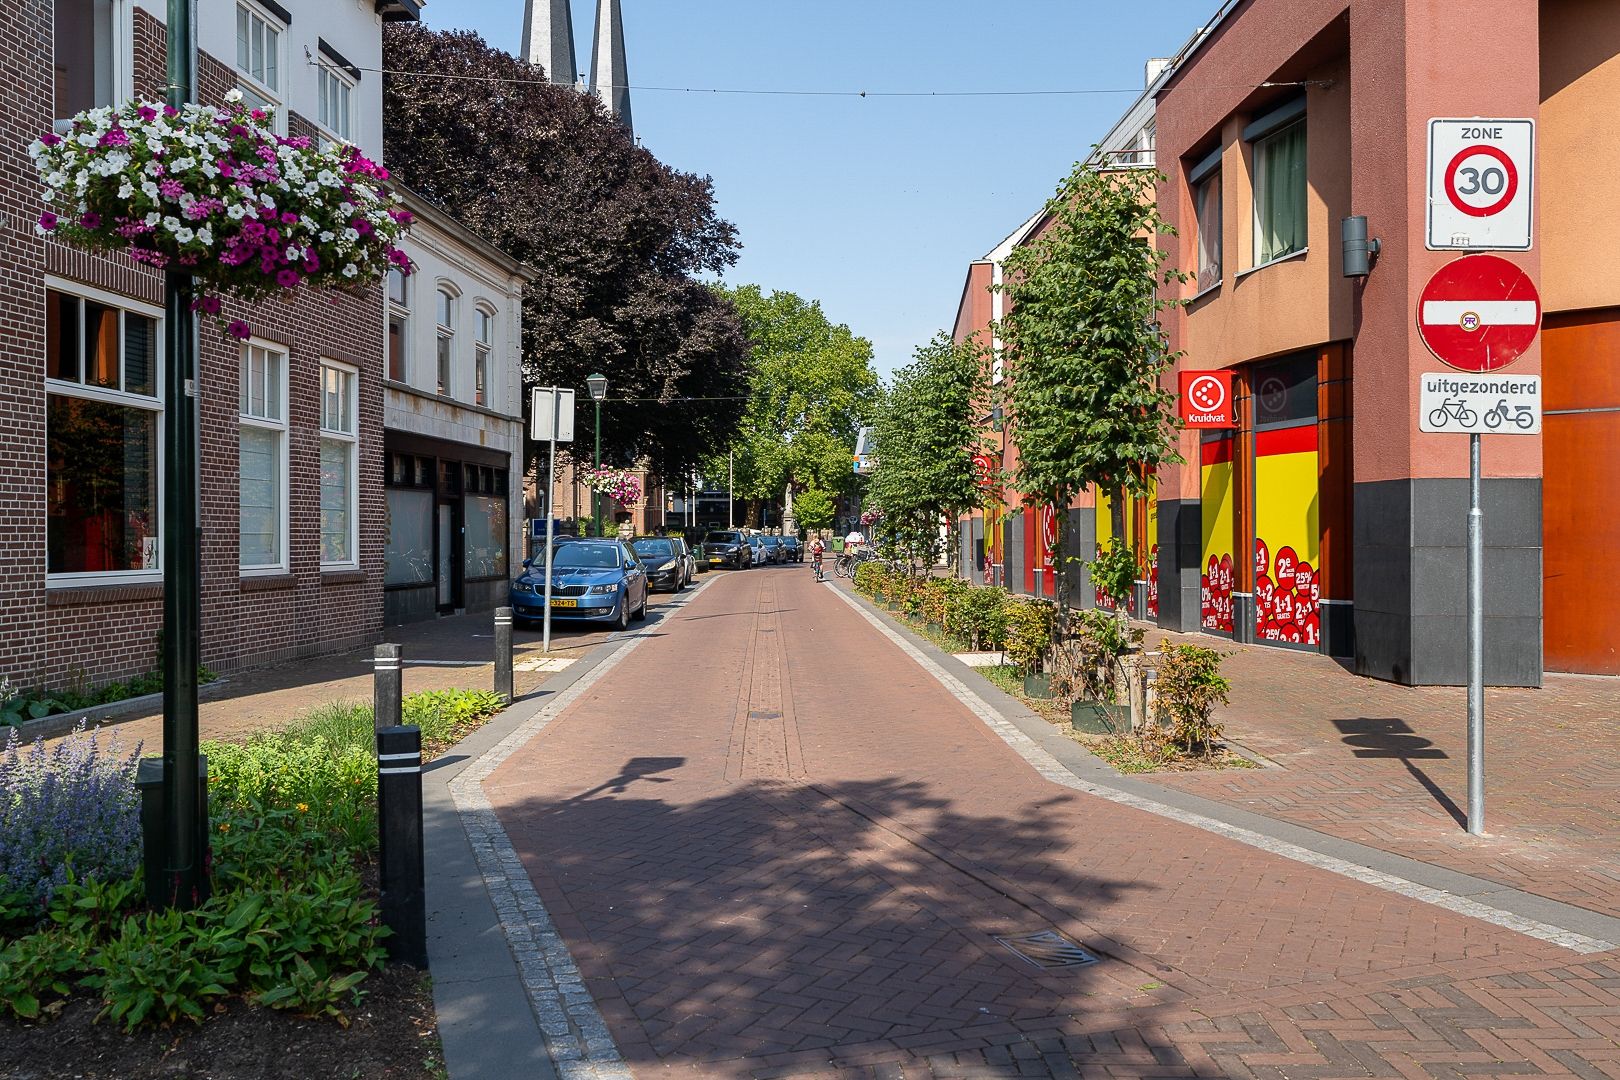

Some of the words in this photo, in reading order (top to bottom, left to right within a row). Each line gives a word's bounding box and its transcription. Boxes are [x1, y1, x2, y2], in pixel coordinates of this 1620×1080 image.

[1461, 127, 1503, 139] ZONE
[1458, 167, 1505, 195] 30
[1427, 378, 1536, 398] uitgezonderd
[1188, 413, 1225, 423] Kruidvat
[1296, 572, 1312, 584] 25%
[1274, 595, 1293, 613] 1+1
